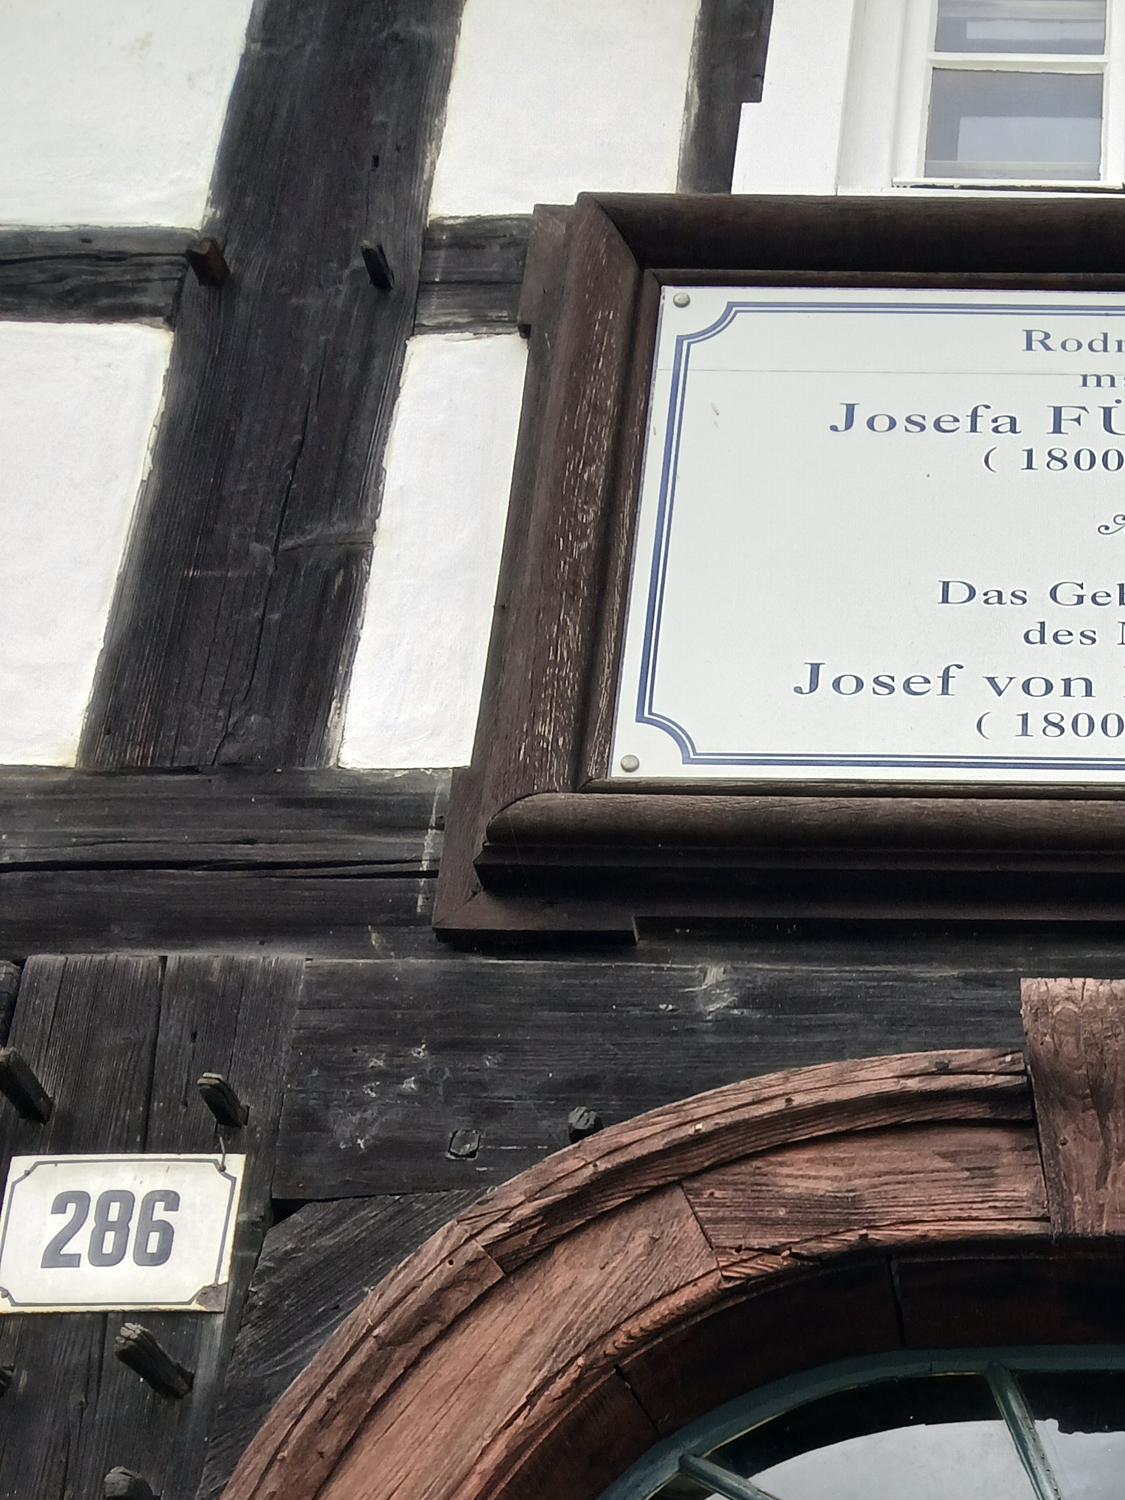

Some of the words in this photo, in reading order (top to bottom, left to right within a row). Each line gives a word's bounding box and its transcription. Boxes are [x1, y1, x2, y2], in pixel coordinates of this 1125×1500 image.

[829, 402, 1022, 435] Josefa
[938, 580, 1028, 606] Das
[1023, 620, 1097, 646] des
[793, 662, 964, 697] Josef
[983, 676, 1095, 698] von
[40, 1189, 181, 1269] 286
